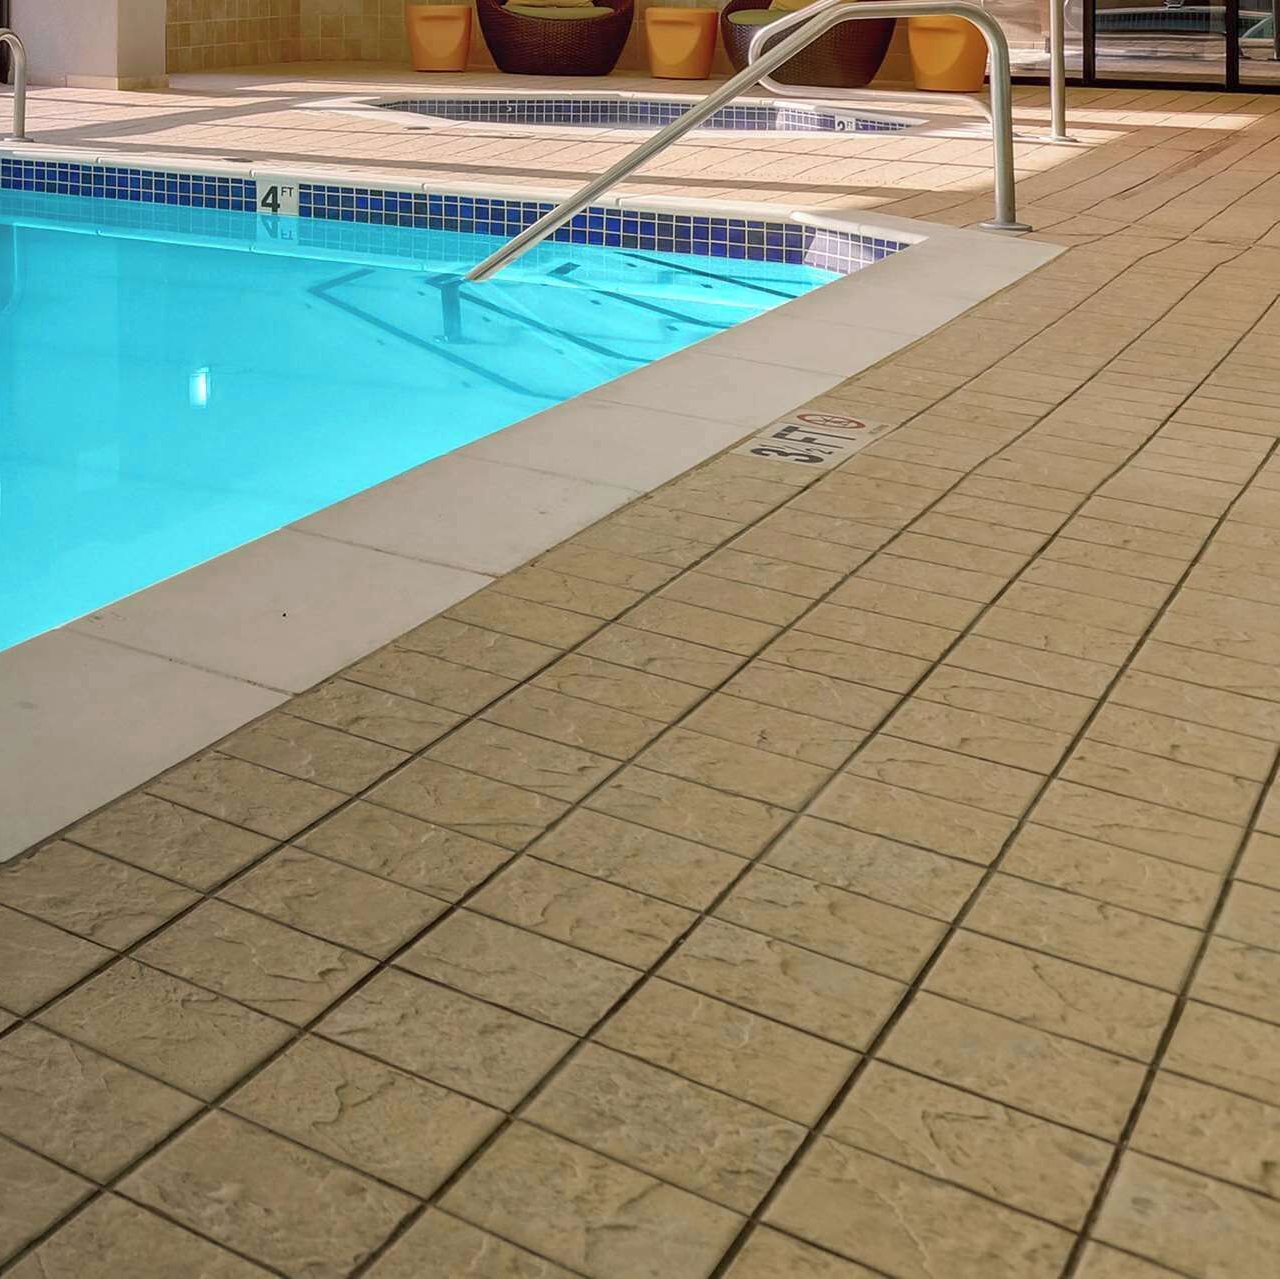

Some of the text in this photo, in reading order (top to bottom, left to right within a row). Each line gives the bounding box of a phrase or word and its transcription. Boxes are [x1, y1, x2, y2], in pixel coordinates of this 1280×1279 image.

[261, 186, 294, 213] 4 FT
[772, 425, 857, 449] FT
